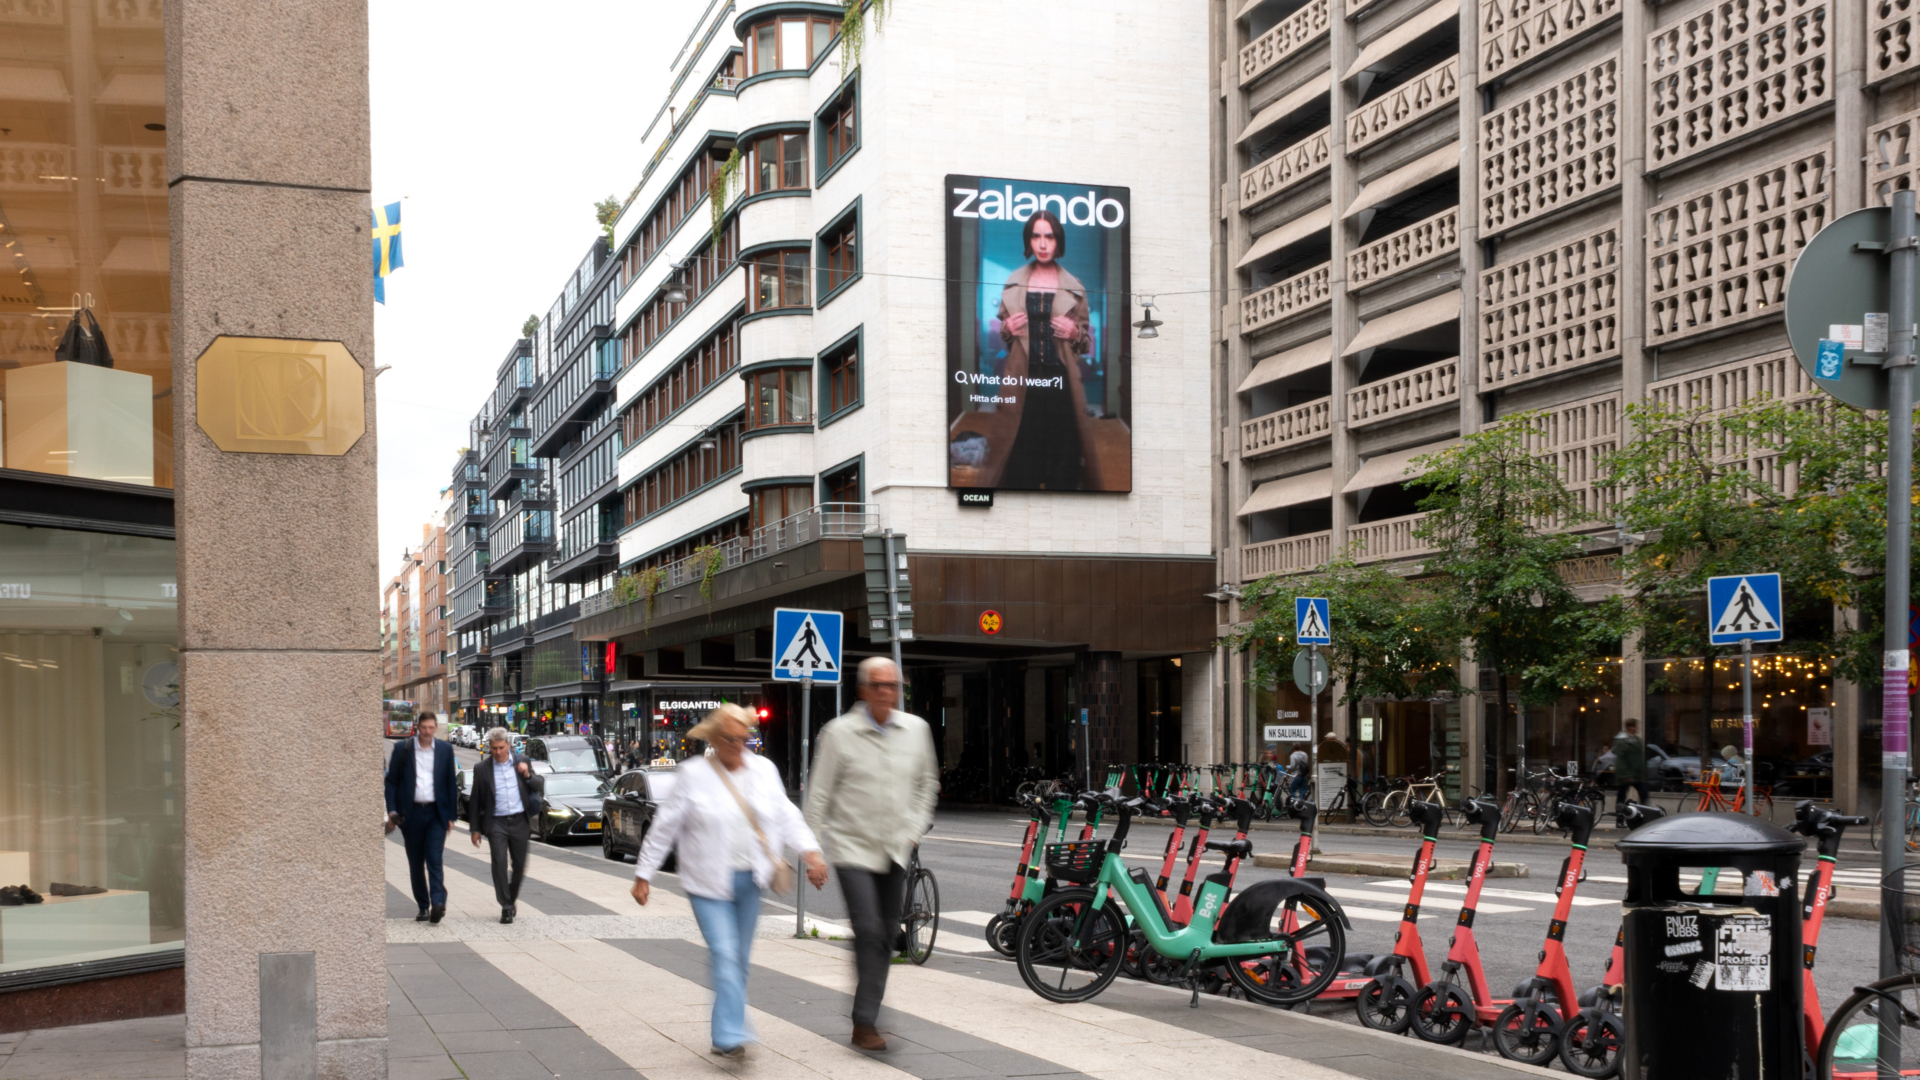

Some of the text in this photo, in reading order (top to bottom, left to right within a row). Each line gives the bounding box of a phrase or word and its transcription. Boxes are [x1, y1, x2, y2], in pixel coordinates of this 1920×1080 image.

[953, 185, 1125, 228] zalando
[969, 373, 1000, 385] What
[1002, 375, 1018, 386] do
[969, 394, 1016, 404] Hitta din stil
[963, 494, 990, 502] OCEAN
[659, 701, 721, 709] ELGIGANTEN
[1726, 718, 1761, 729] BAKRY
[1268, 728, 1307, 738] NK SALUHALL
[1298, 851, 1307, 867] voi.
[1417, 858, 1428, 876] voi.
[1473, 860, 1485, 879] voi.
[1564, 868, 1577, 888] voi.
[1816, 885, 1828, 907] voi.
[1198, 893, 1217, 918] Bolt
[1665, 916, 1698, 927] PNUTZ
[1666, 925, 1699, 938] PUBBS
[1719, 955, 1767, 965] PROJECTS
